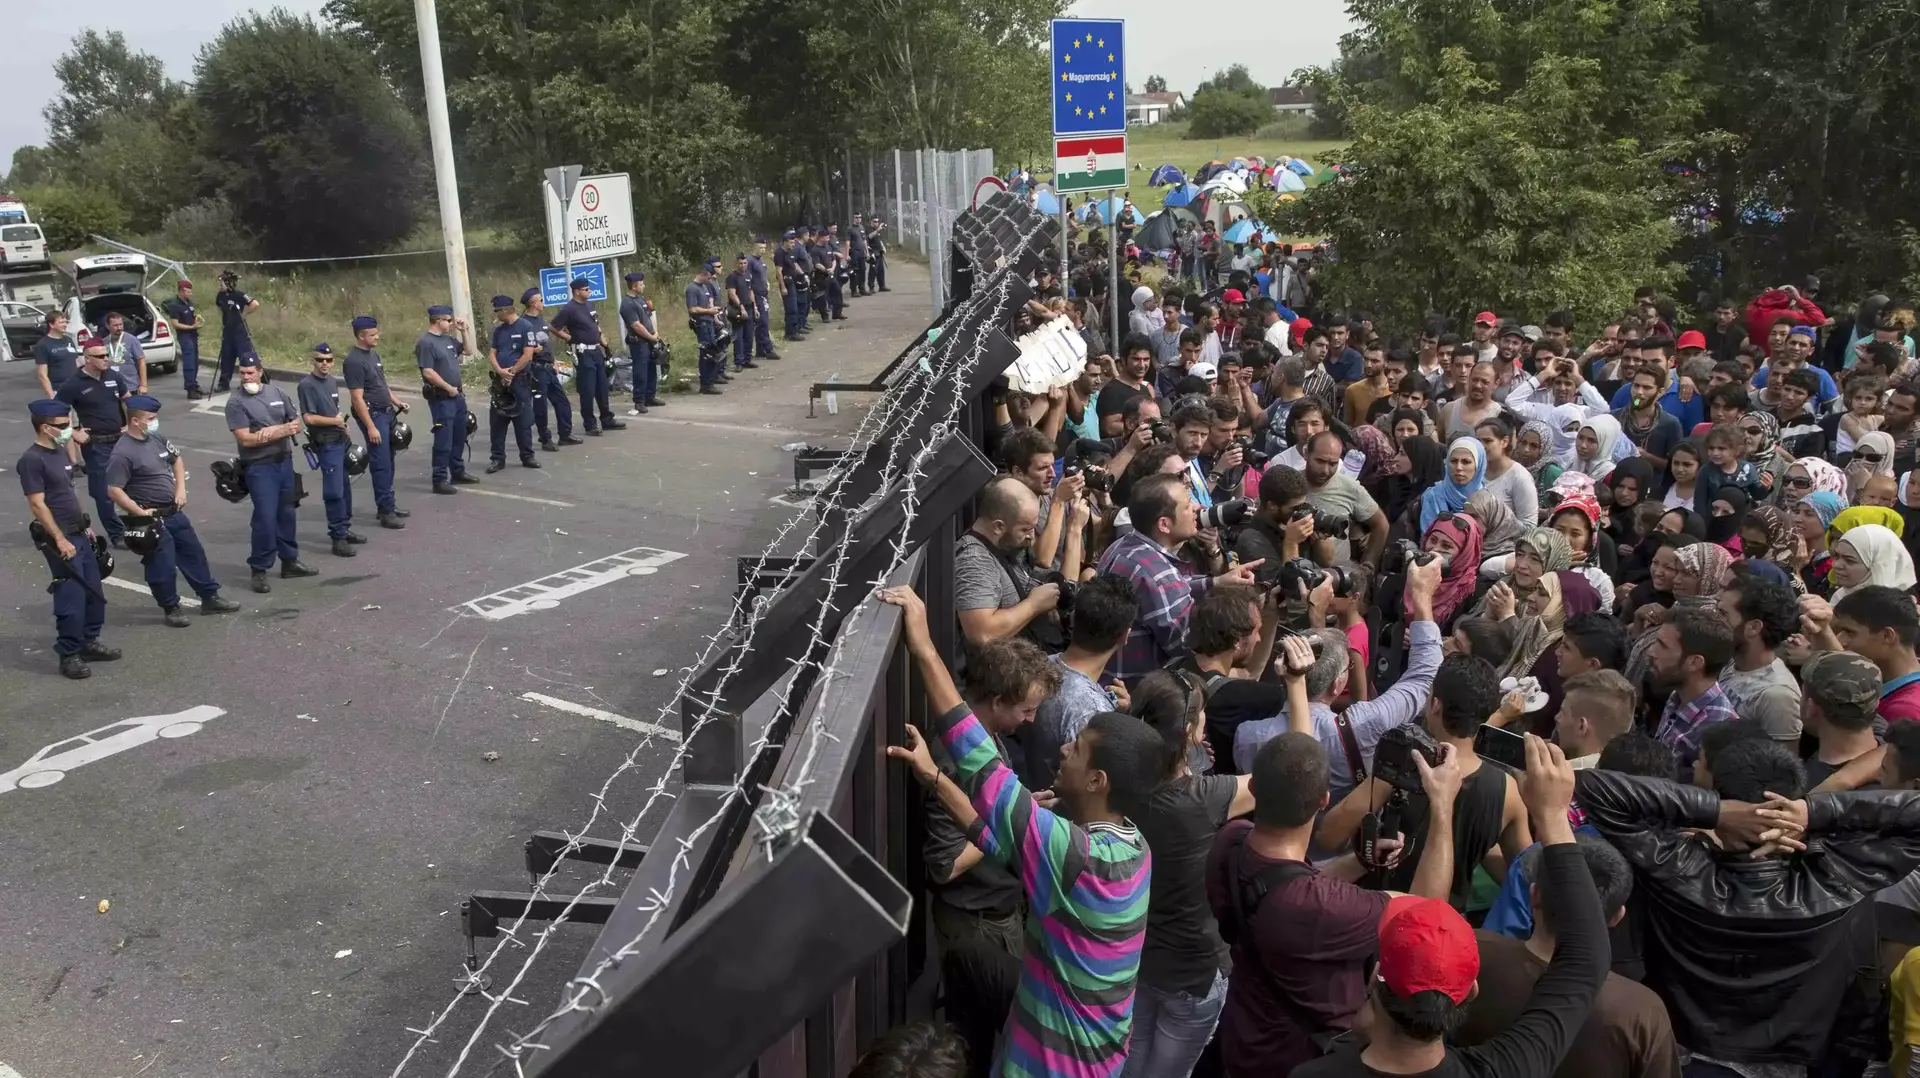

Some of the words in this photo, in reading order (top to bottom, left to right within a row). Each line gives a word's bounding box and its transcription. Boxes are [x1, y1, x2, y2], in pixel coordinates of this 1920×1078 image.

[1068, 71, 1111, 83] Magyarország
[585, 192, 595, 204] 20
[577, 215, 609, 232] RÖSZKE
[560, 230, 629, 255] HTÁRÁTKELŐHELY
[546, 293, 568, 301] VIDEO
